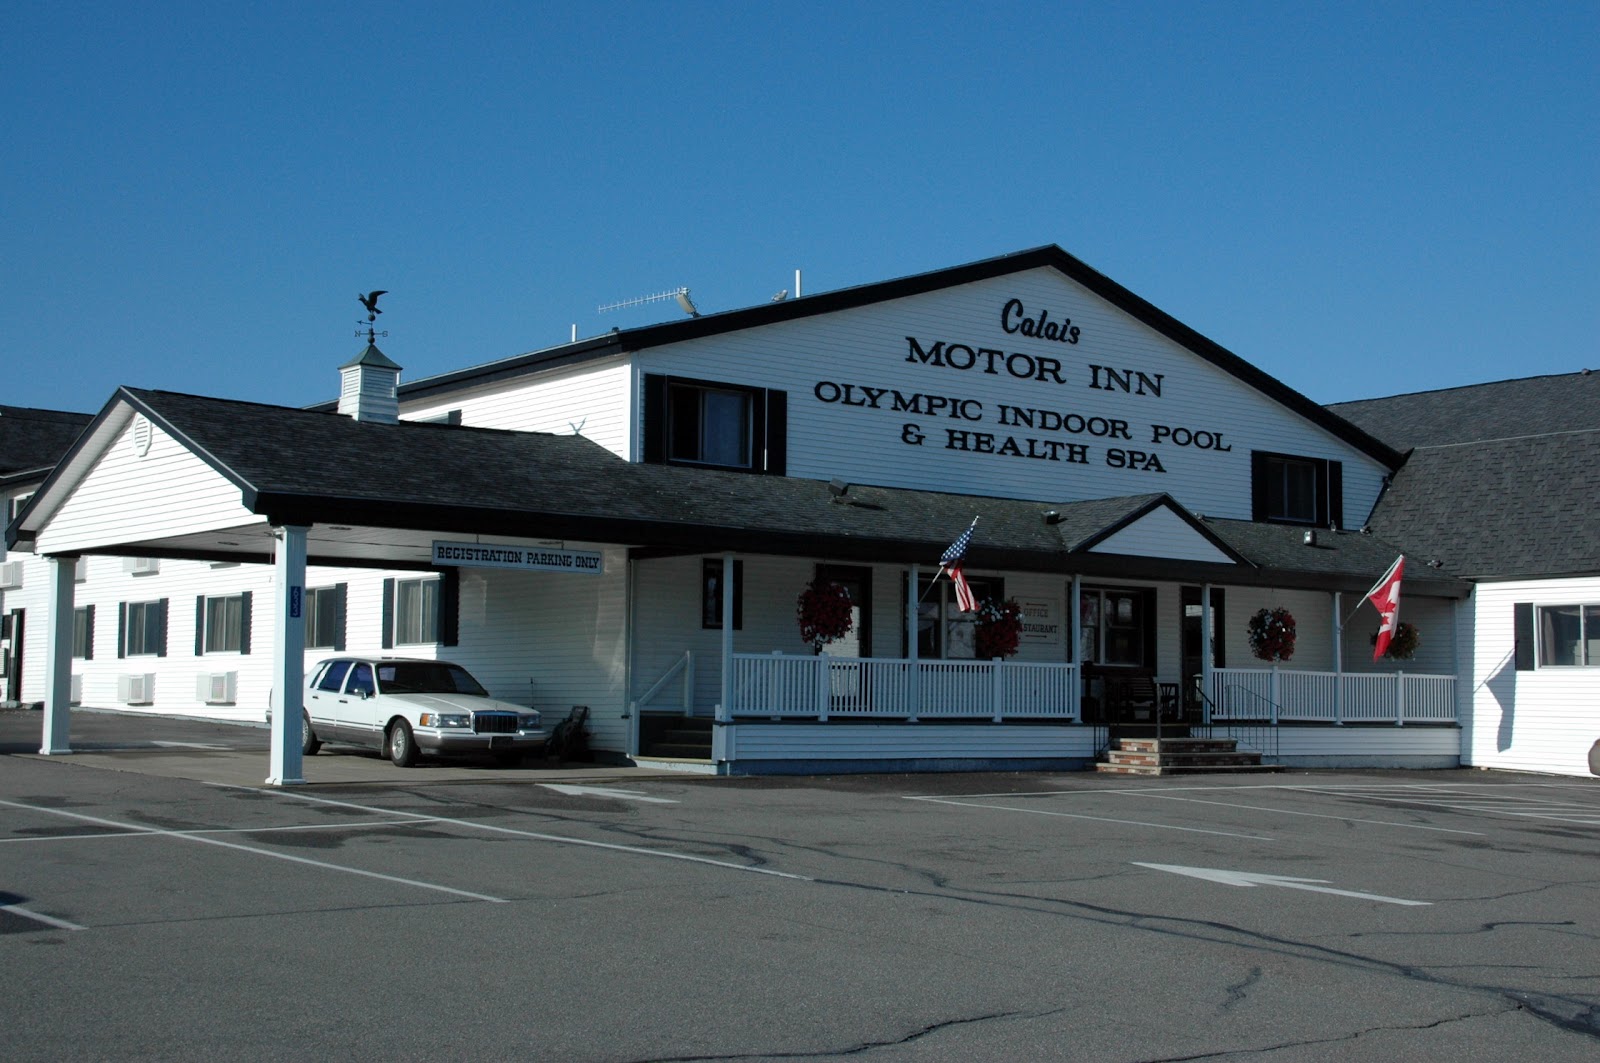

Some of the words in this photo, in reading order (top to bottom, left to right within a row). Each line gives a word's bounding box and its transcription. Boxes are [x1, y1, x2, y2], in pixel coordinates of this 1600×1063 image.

[1001, 298, 1081, 345] Calais
[905, 336, 1067, 385] MOTOR
[1088, 364, 1165, 398] INN
[814, 381, 983, 422] OLYMPIC
[998, 404, 1132, 441] INDOOR
[1150, 424, 1232, 453] POOL
[901, 423, 926, 446] &
[945, 428, 1090, 465] HEALTH
[1105, 448, 1167, 473] SPA
[437, 546, 522, 563] REGISTRATION
[526, 552, 572, 567] PARKING
[575, 556, 599, 568] ONLY
[1021, 624, 1057, 633] STAURANT
[1023, 608, 1048, 617] OFFICE
